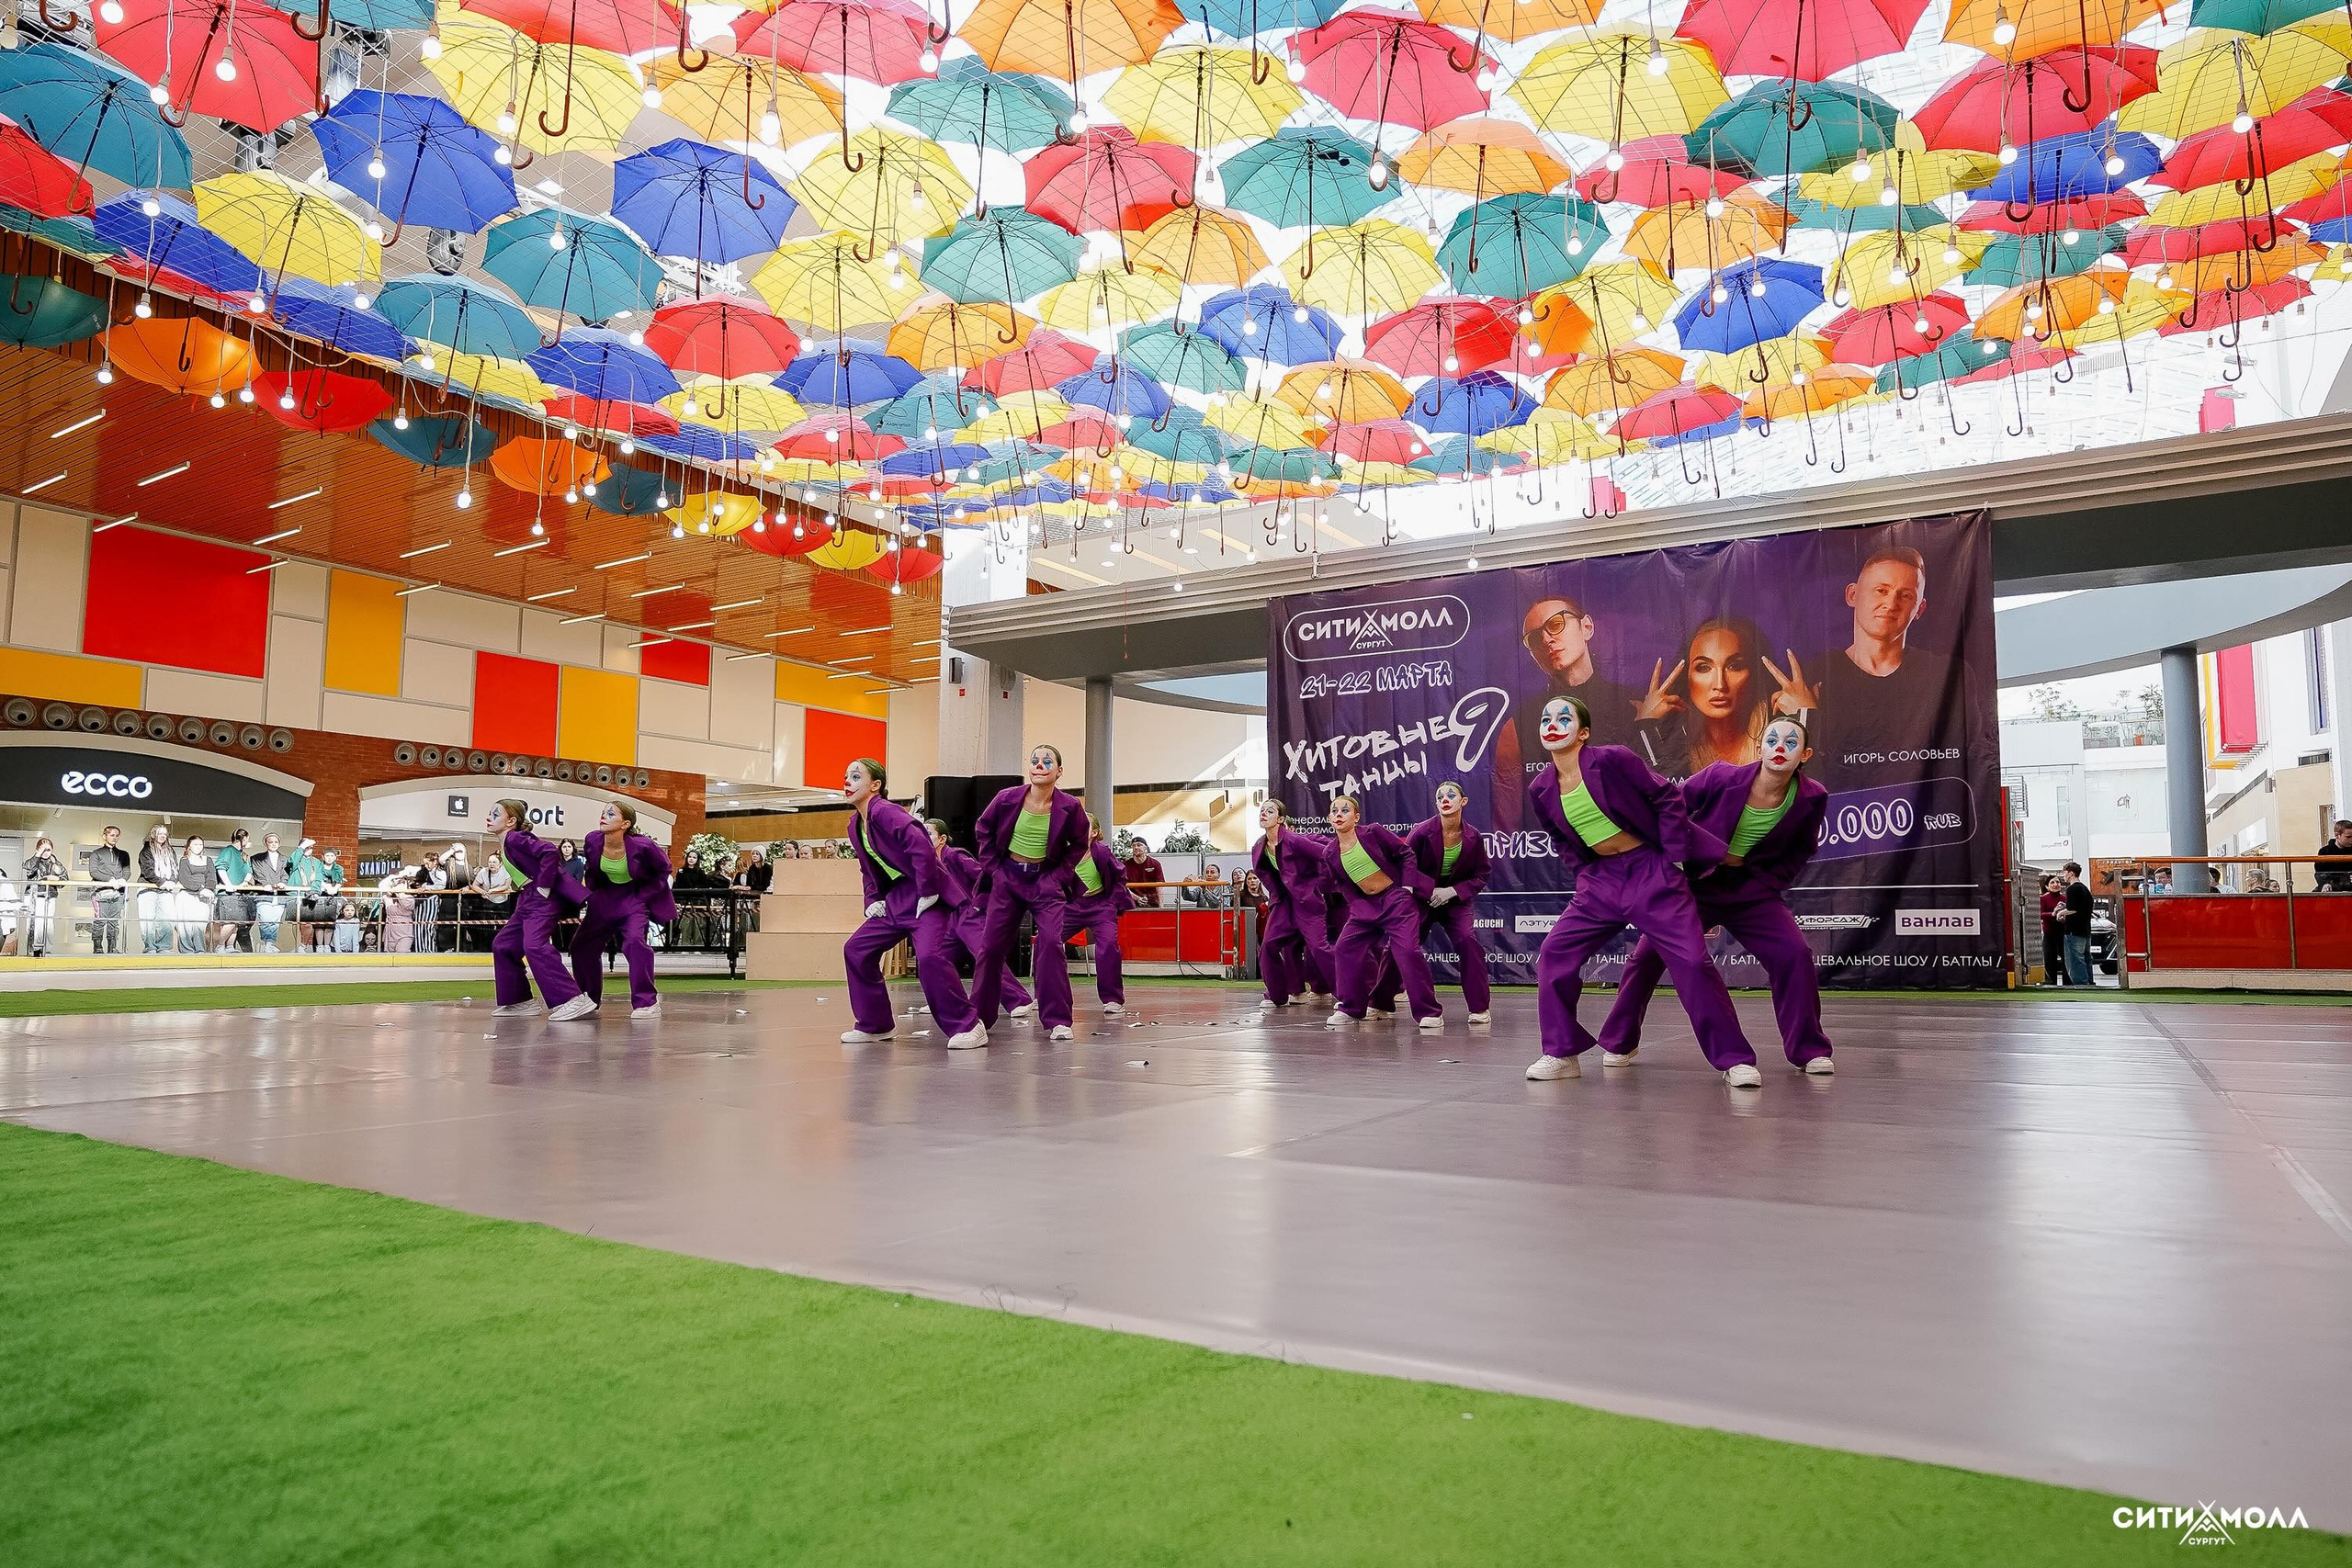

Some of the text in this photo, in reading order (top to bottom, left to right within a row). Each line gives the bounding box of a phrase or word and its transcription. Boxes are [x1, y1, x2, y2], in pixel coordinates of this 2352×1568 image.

[1356, 639, 1386, 649] СУРГУТ
[1299, 660, 1453, 699] 21-22 МАРТА
[1844, 748, 1961, 764] ИГОРЬ СОЛОВЬЕВ
[1319, 750, 1428, 801] ТАНЦЫ
[61, 771, 153, 799] ecco
[528, 805, 564, 827] ort
[1924, 813, 1962, 830] RUB
[1473, 919, 1504, 928] AGUCHI
[1901, 917, 1974, 928] ванлав
[1505, 953, 1533, 964] ШОУ
[1894, 954, 1928, 966] ШОУ
[1941, 955, 1992, 966] БАТТЛЫ
